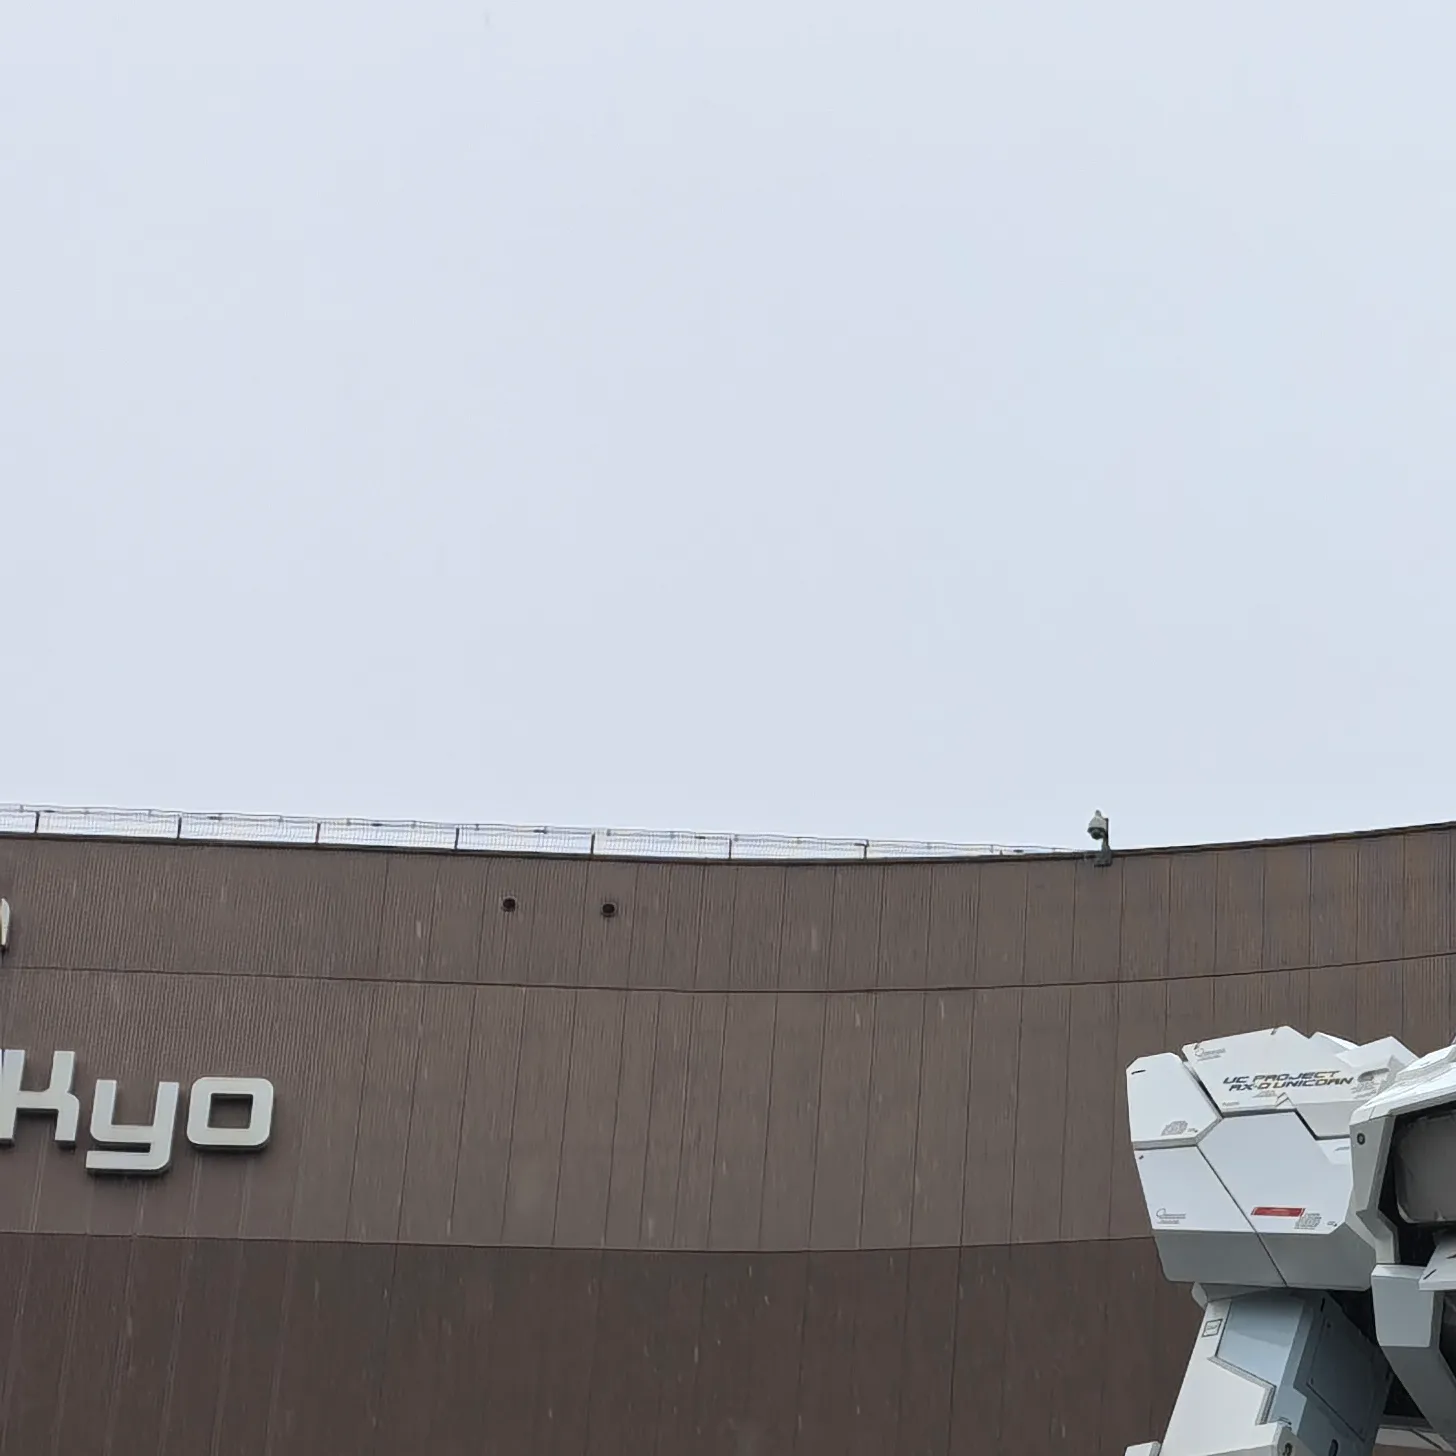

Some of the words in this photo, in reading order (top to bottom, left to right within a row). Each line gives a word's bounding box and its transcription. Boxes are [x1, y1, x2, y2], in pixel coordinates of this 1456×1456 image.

[1223, 1075, 1250, 1085] UC
[1252, 1070, 1342, 1083] PROJECT
[1273, 1076, 1354, 1090] UNICORN
